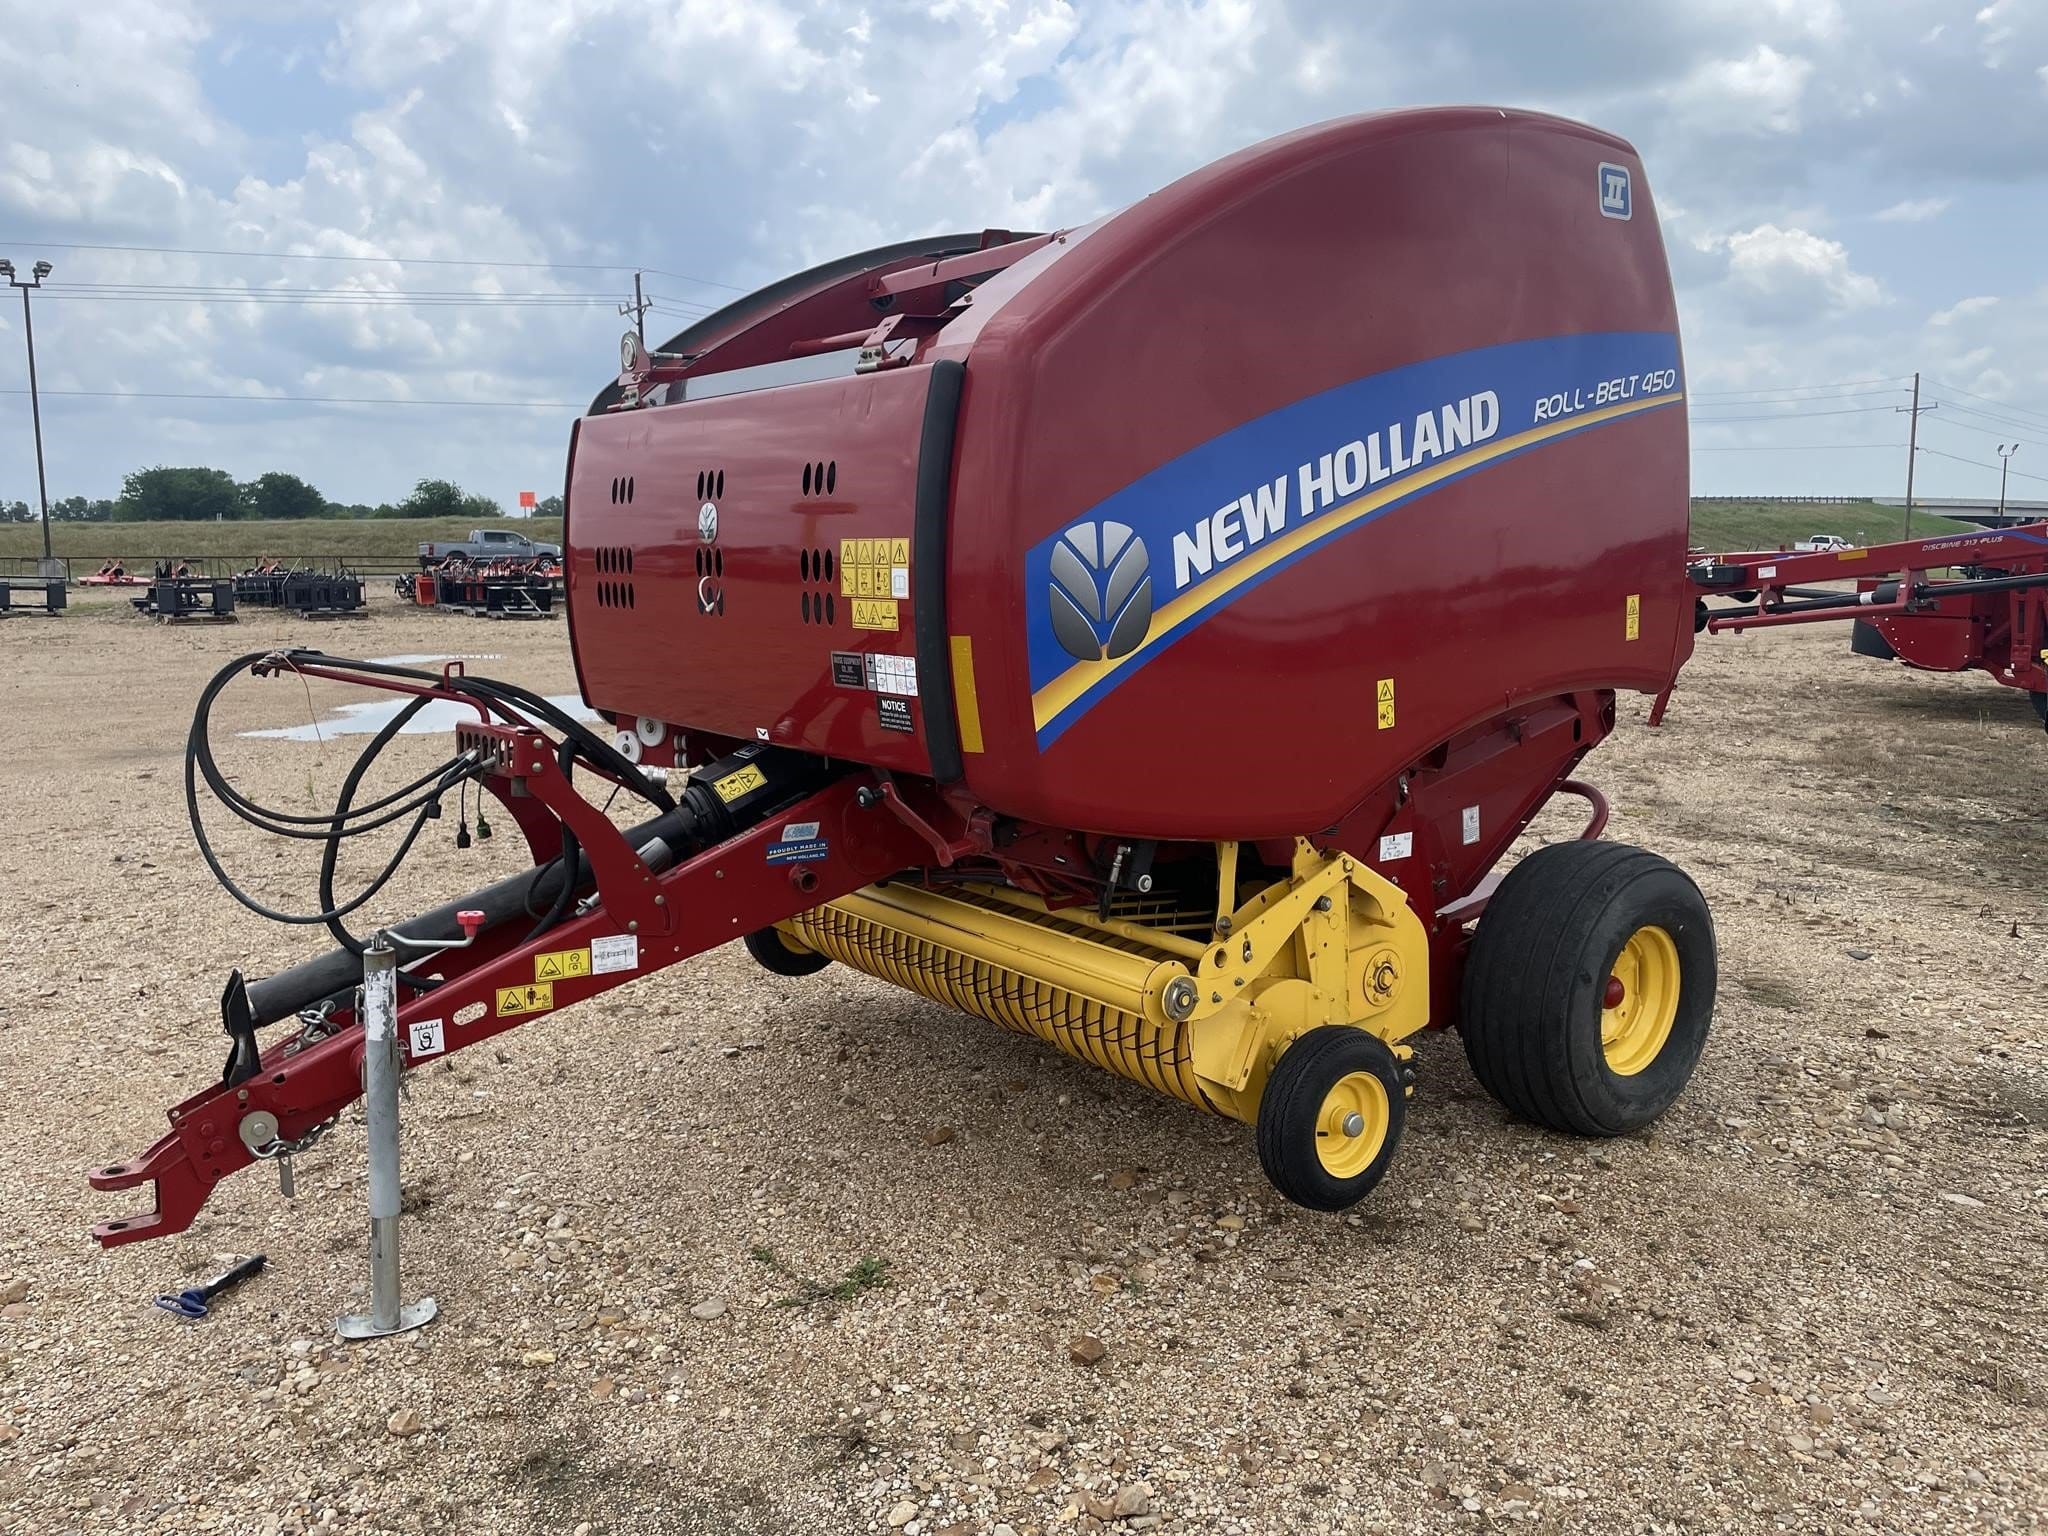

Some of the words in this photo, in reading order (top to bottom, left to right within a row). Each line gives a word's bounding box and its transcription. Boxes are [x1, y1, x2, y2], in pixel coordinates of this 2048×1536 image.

[1641, 368, 1676, 394] 450
[1172, 474, 1288, 590] NEW
[1298, 390, 1500, 517] HOLLAND
[1922, 541, 1961, 551] DISCBINE
[1980, 536, 2004, 544] PLUS
[881, 699, 907, 713] NOTICE
